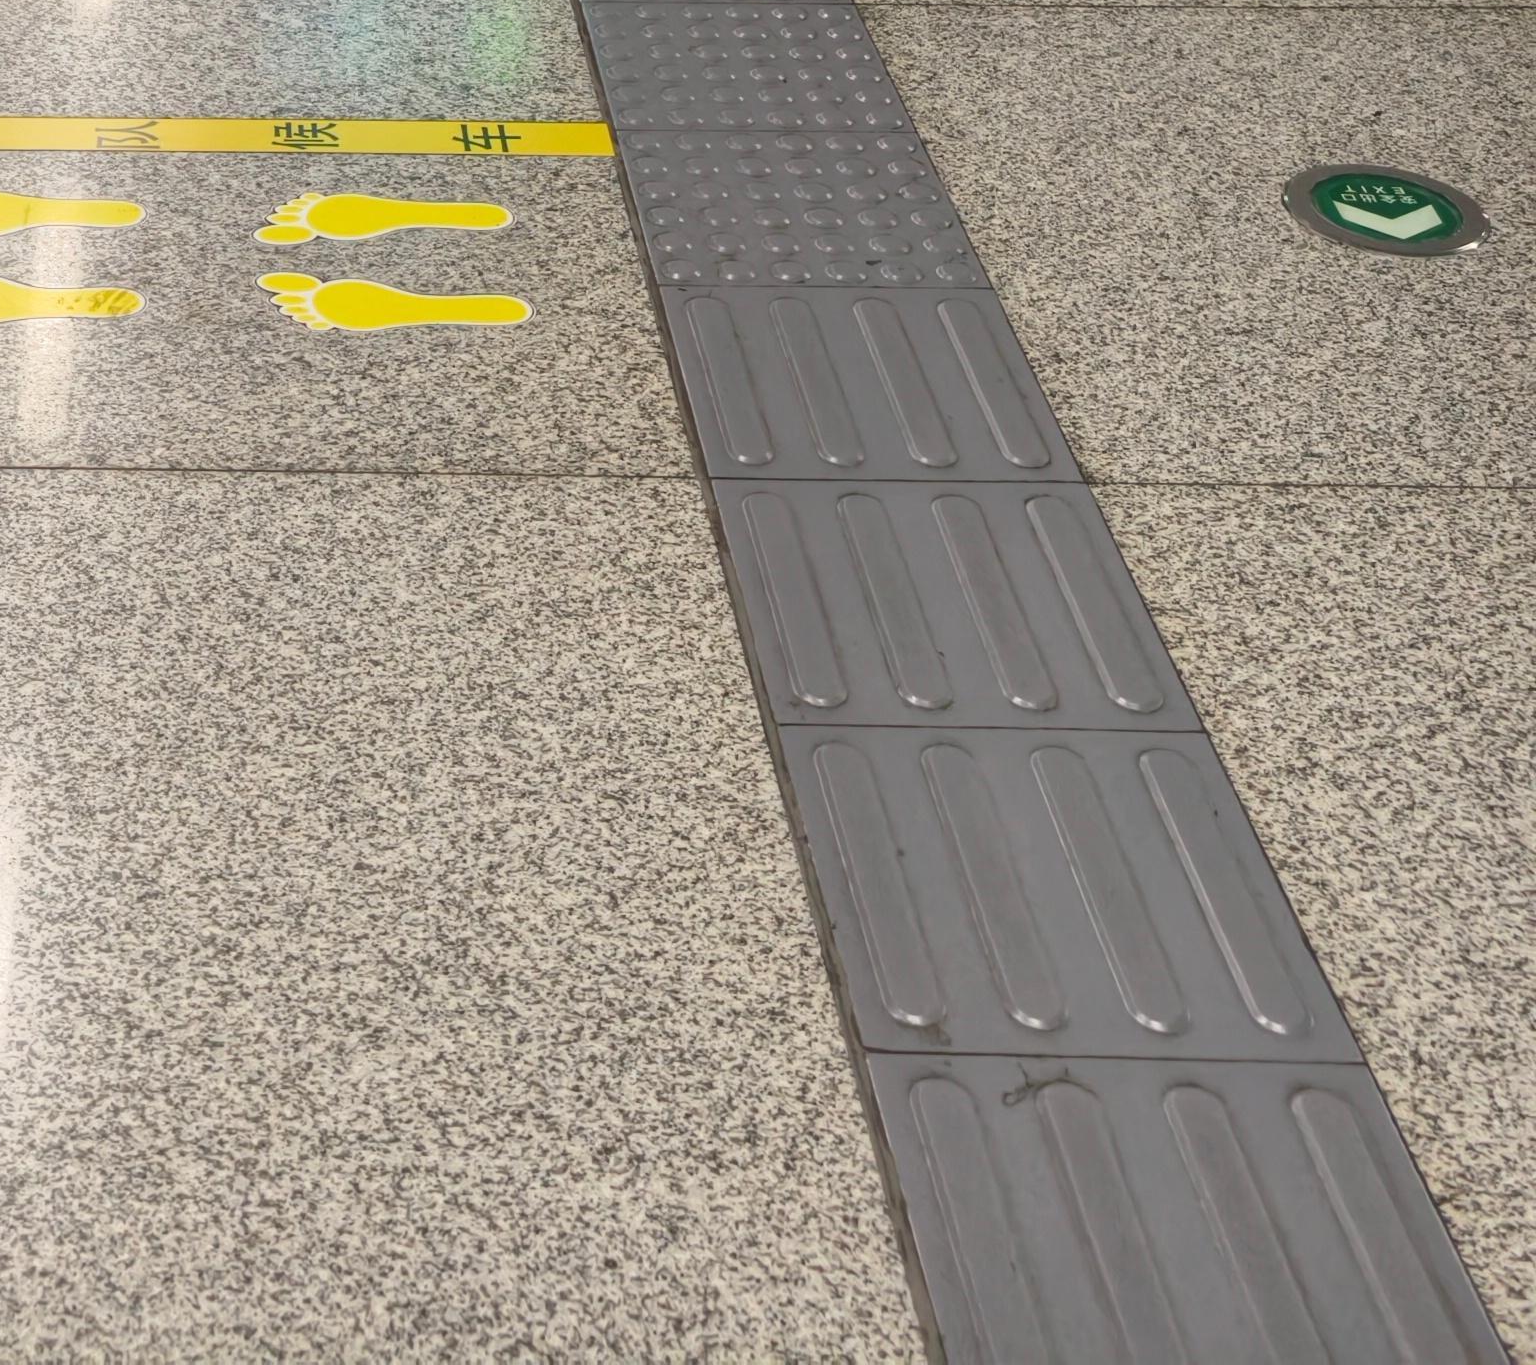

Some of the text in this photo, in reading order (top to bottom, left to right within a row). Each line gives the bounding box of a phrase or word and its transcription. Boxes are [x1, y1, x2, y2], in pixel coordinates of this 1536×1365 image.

[1346, 185, 1406, 195] EXIT
[1341, 193, 1418, 205] 安全出口
